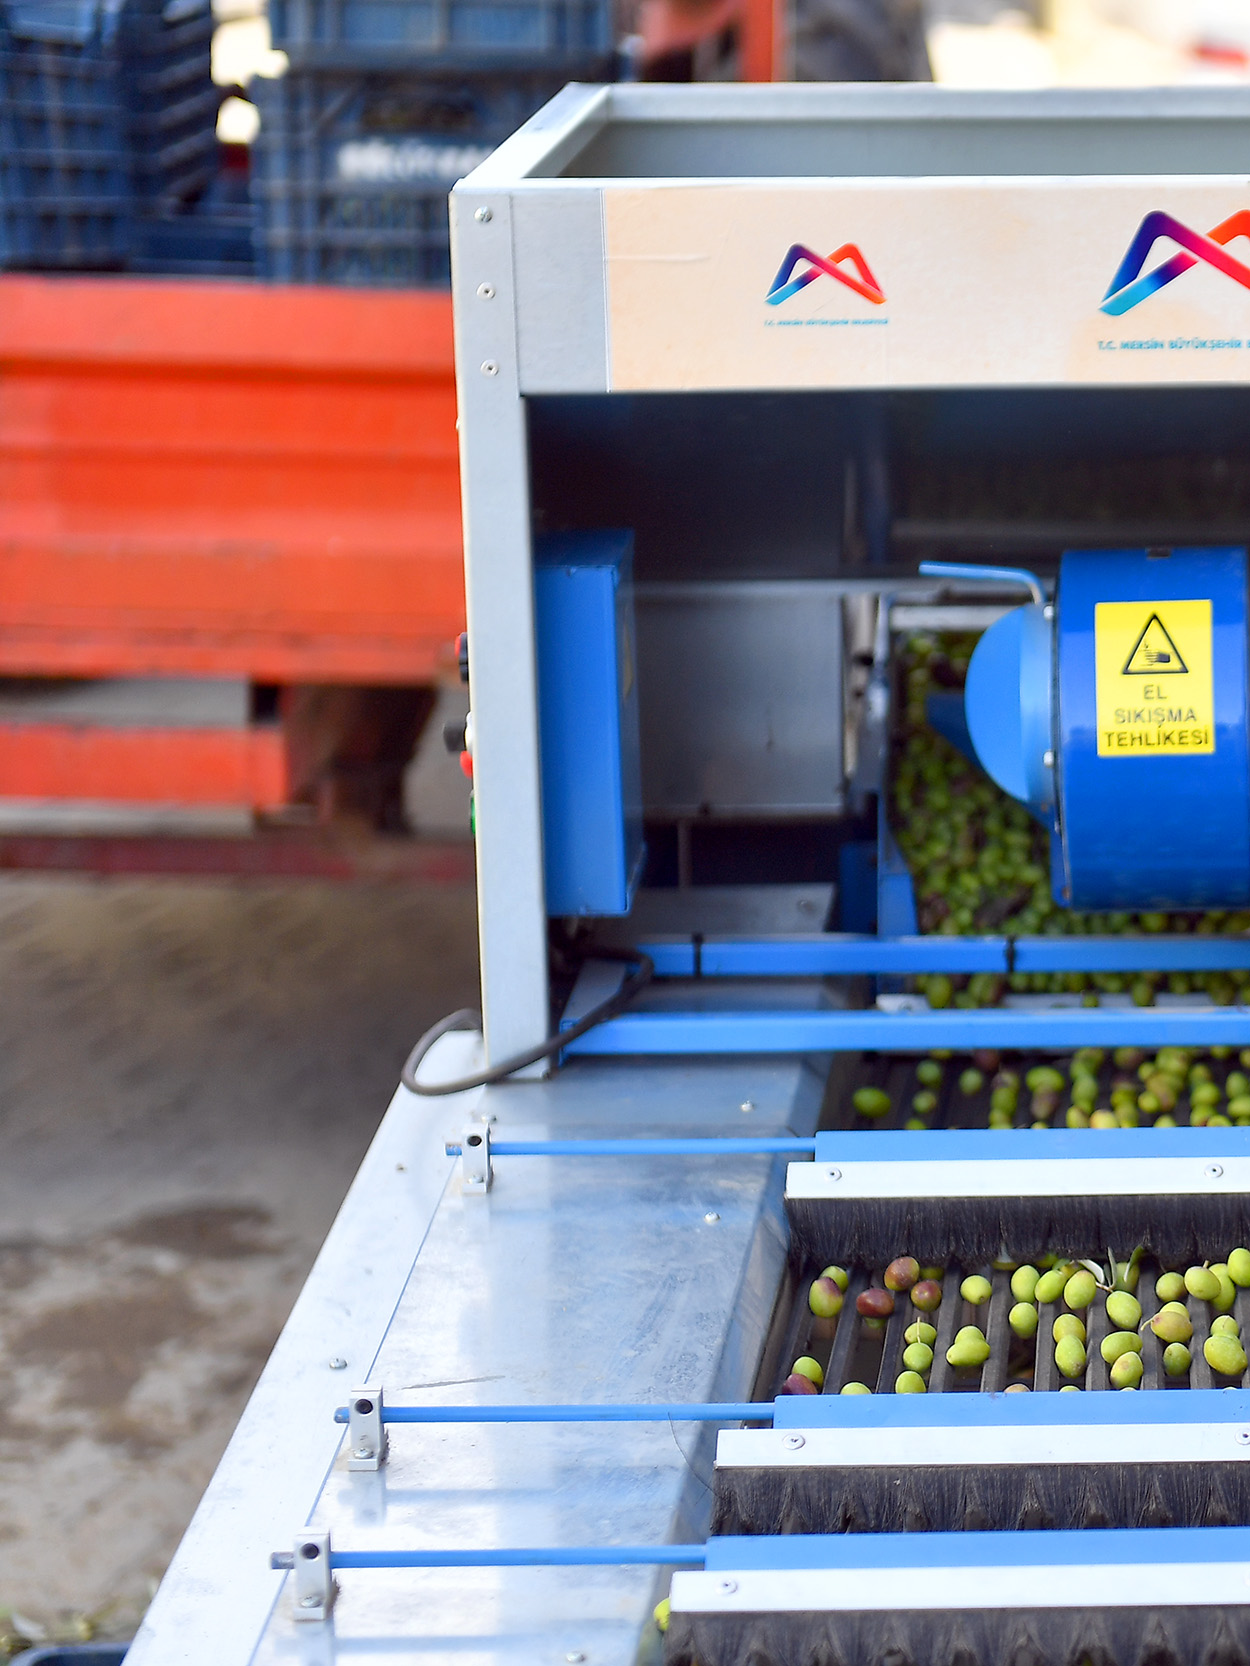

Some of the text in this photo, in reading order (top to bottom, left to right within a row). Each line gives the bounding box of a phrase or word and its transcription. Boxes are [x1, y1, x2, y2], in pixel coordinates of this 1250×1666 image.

[1120, 338, 1164, 349] MERSİN
[1143, 685, 1168, 700] EL
[1114, 708, 1197, 728] SIKIŞMA
[1104, 725, 1208, 747] TEHLİKESİ
